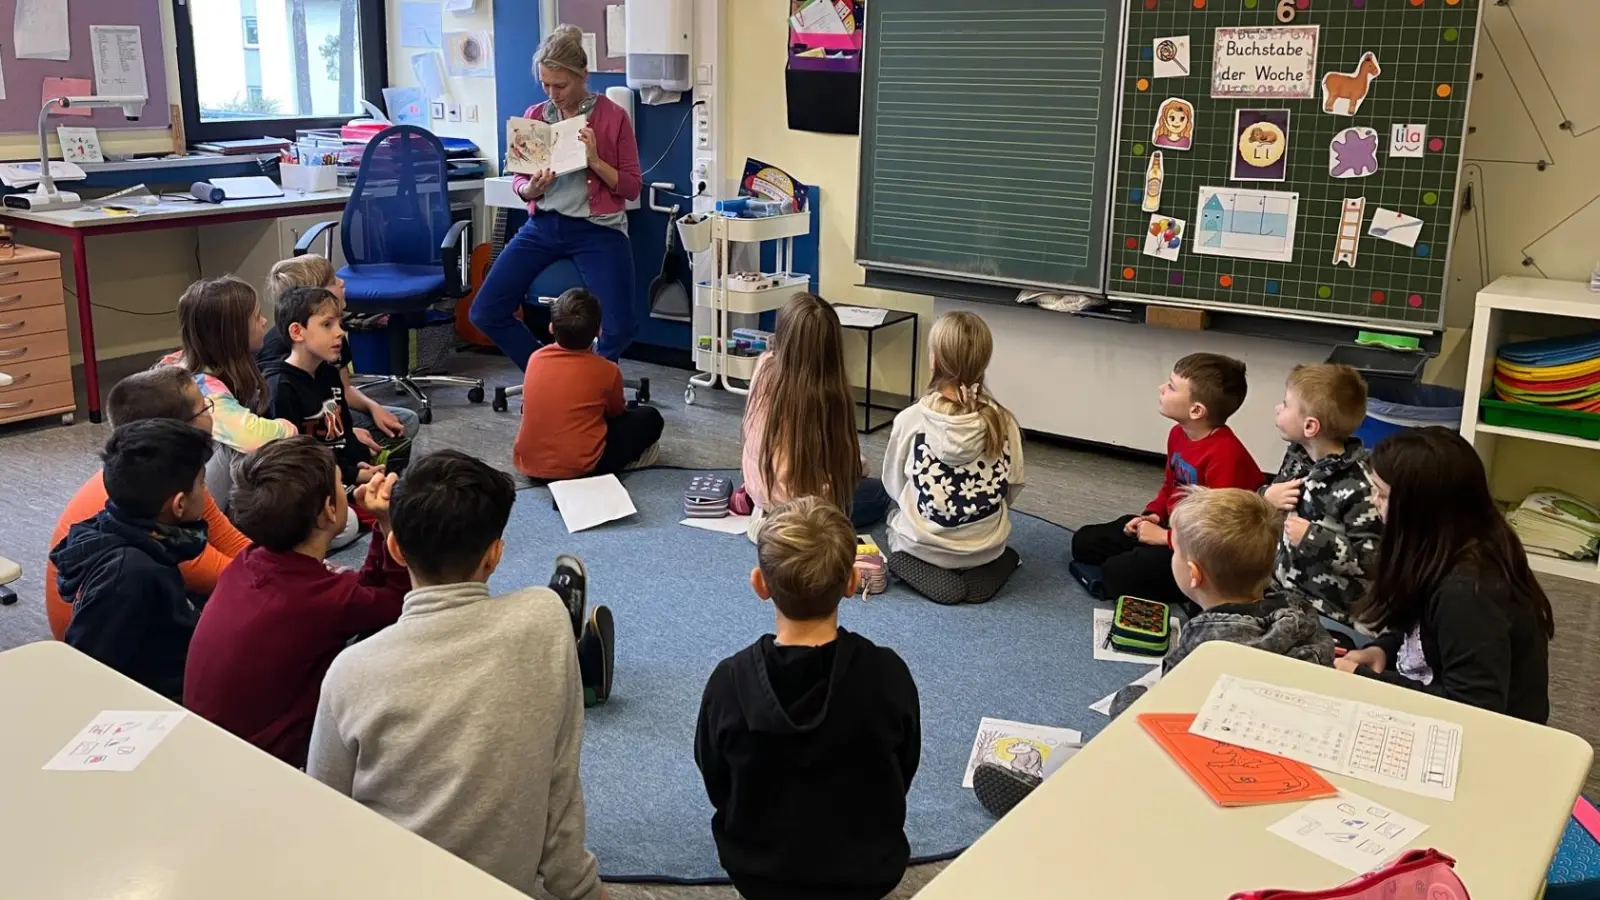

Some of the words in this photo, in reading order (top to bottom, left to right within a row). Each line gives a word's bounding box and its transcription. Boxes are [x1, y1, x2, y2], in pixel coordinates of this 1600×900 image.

[1277, 0, 1296, 22] 6
[1226, 40, 1304, 56] Buchstabe
[1221, 66, 1246, 81] der
[1255, 65, 1304, 81] Woche
[1396, 128, 1420, 143] lila
[1253, 148, 1261, 159] L
